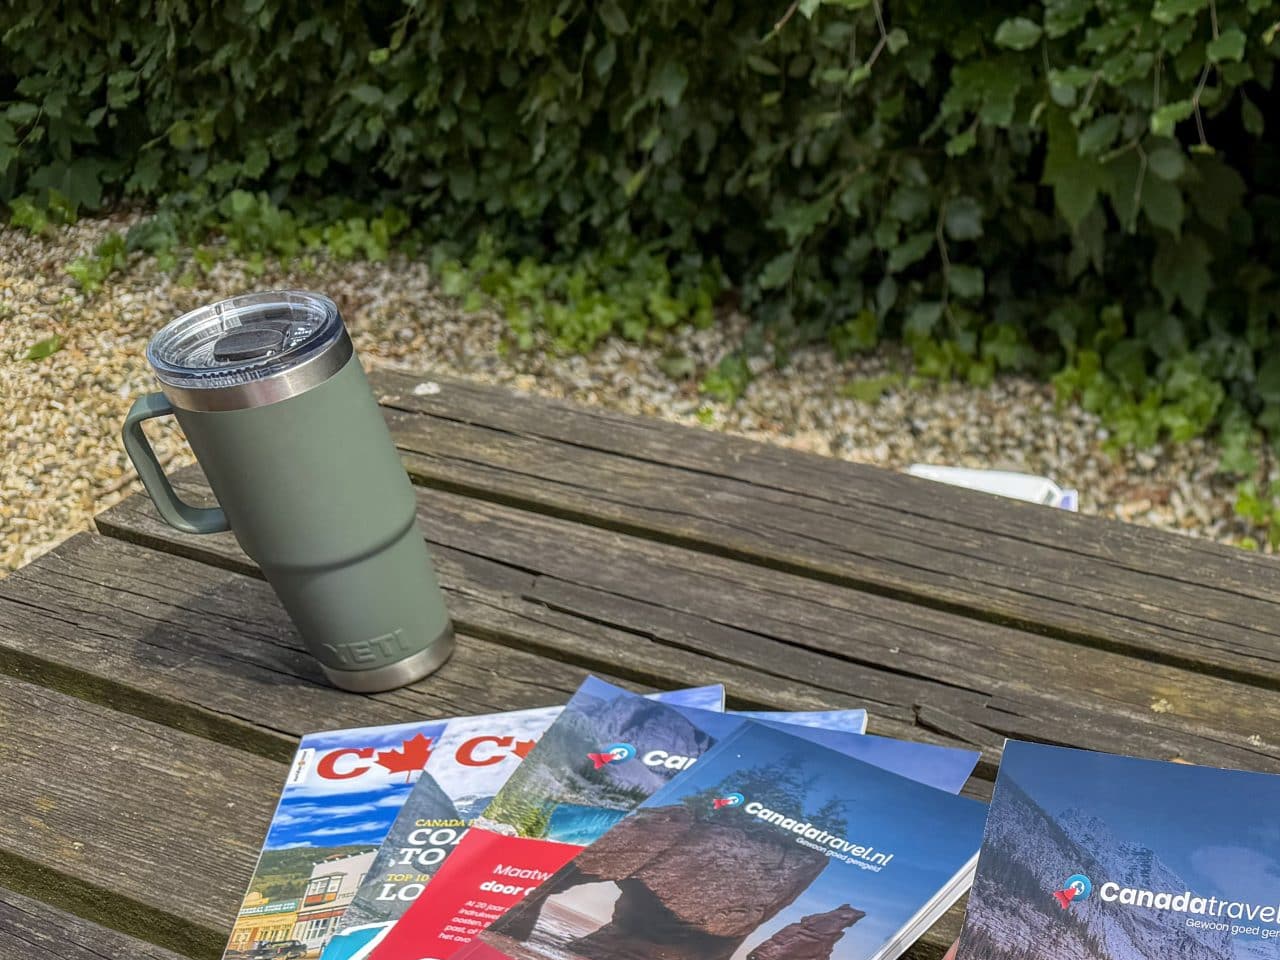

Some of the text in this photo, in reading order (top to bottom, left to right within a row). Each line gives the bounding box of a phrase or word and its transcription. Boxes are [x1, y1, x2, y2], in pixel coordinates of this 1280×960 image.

[321, 627, 407, 664] YETI
[415, 819, 465, 828] CANADA
[745, 802, 893, 867] Canadatravel.nl
[796, 837, 884, 874] Gewoon goed geregeld
[386, 873, 413, 882] TOP
[480, 880, 523, 896] door
[1185, 918, 1230, 933] Gewoon
[1231, 925, 1260, 937] goed
